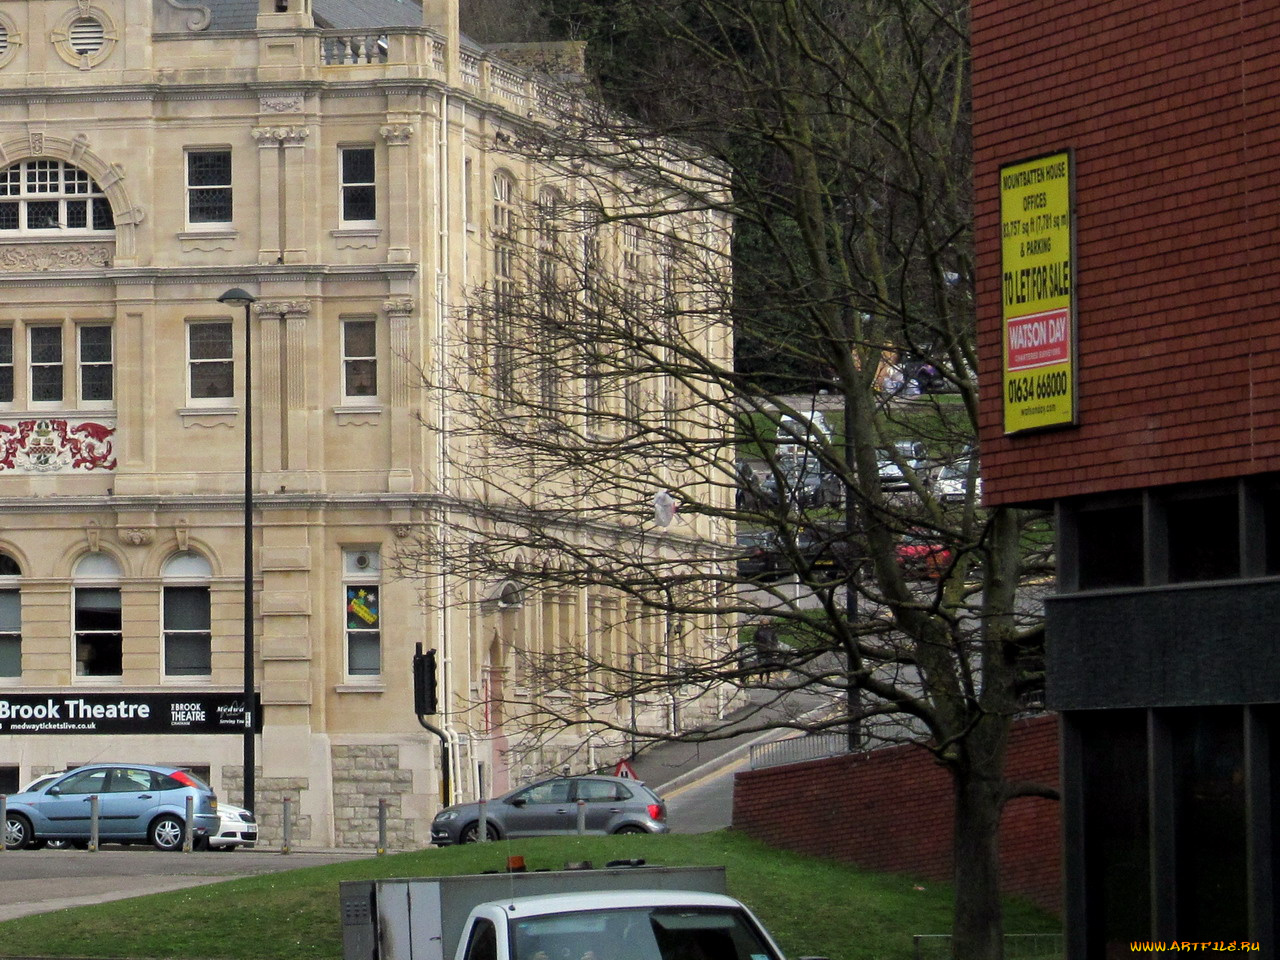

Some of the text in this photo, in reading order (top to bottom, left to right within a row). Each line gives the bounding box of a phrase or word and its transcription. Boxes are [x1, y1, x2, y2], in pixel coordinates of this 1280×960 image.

[1002, 161, 1065, 190] MOUNTBATTEN HOUSE
[1023, 192, 1046, 211] OFFICES
[1020, 237, 1051, 258] & PARKING
[1004, 271, 1013, 306] TO
[1049, 260, 1069, 298] SALE
[1009, 316, 1066, 350] WATSON DAY
[1008, 370, 1067, 404] 01634 668000
[64, 699, 150, 719] Theatre
[170, 711, 206, 721] THEATRE
[175, 703, 201, 711] BROOK
[10, 722, 96, 731] medwayticketslive.co.uk
